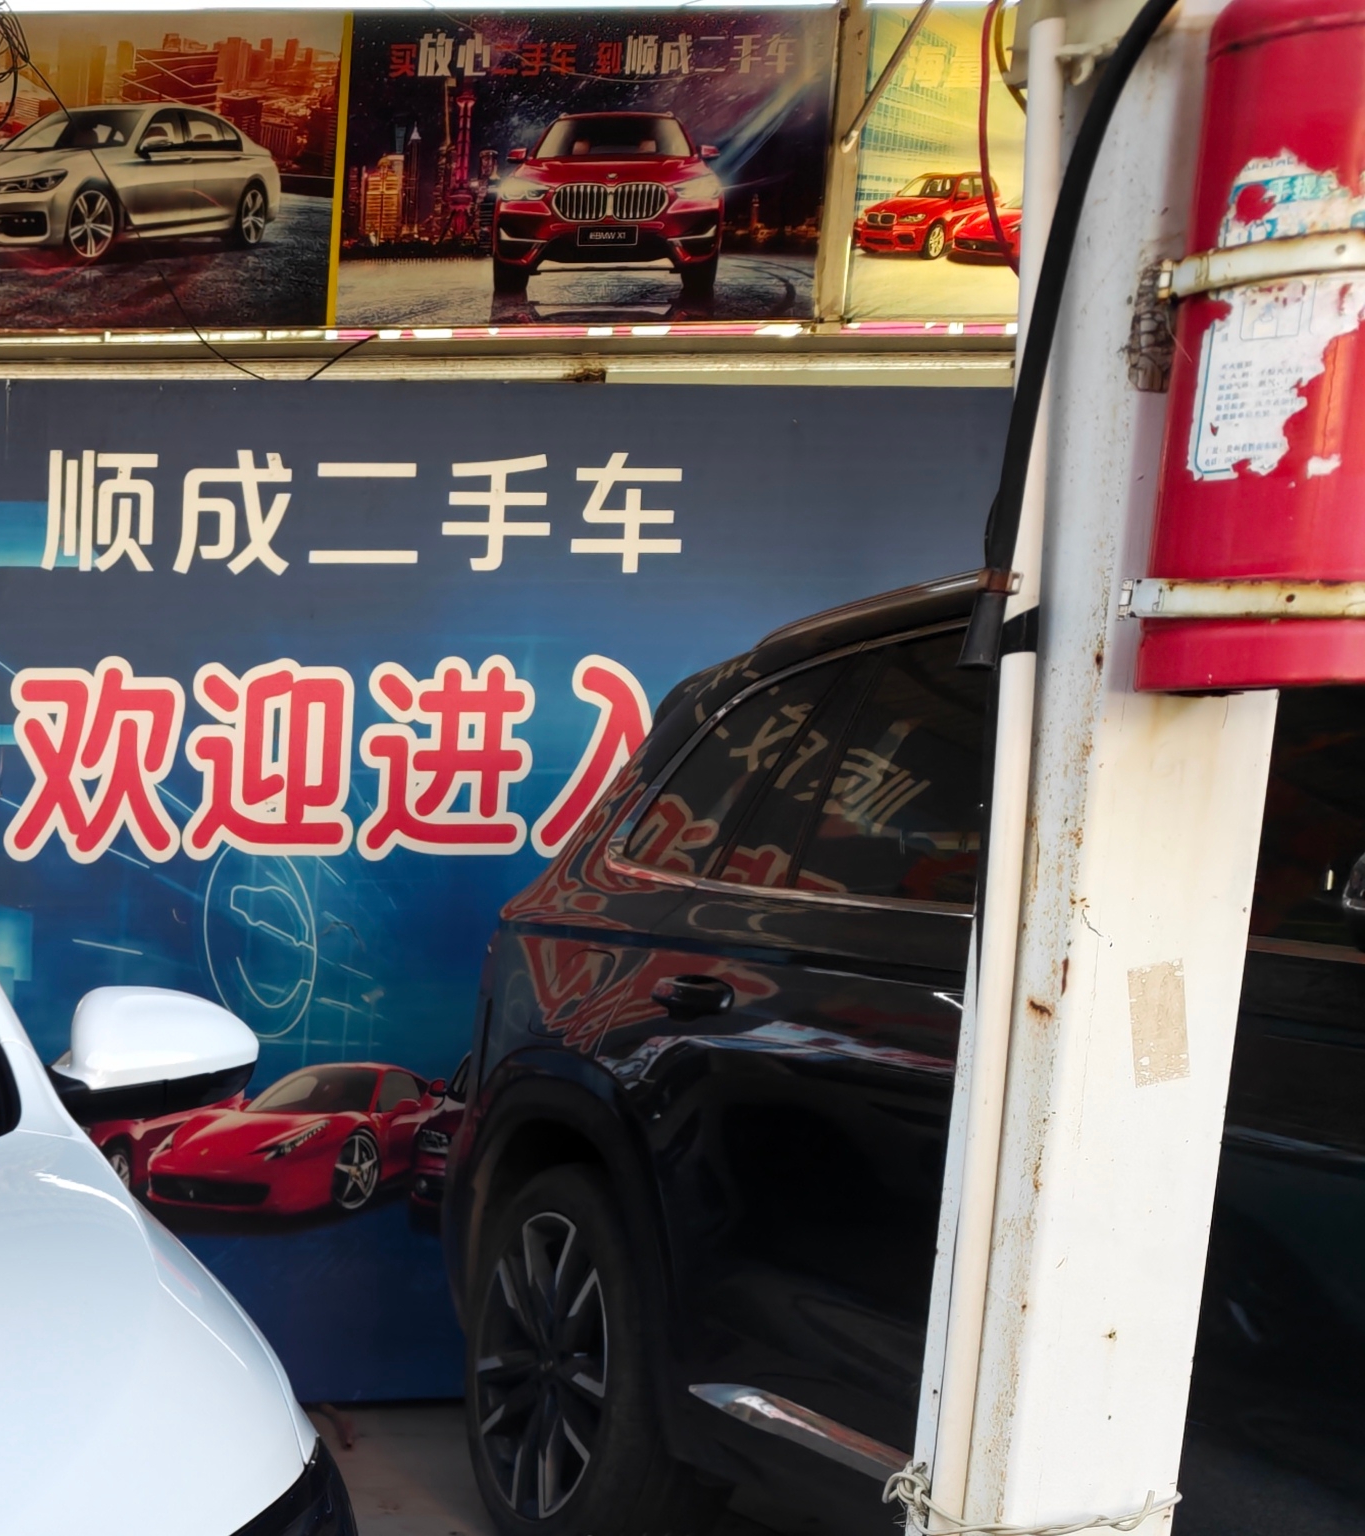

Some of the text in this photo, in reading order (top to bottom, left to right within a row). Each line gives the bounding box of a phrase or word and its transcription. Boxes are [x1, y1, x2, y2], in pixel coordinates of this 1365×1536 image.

[389, 32, 797, 80] 买放心二手车 到顺成二手车
[41, 449, 684, 576] 顺成二手车
[4, 655, 654, 862] 欢迎进入
